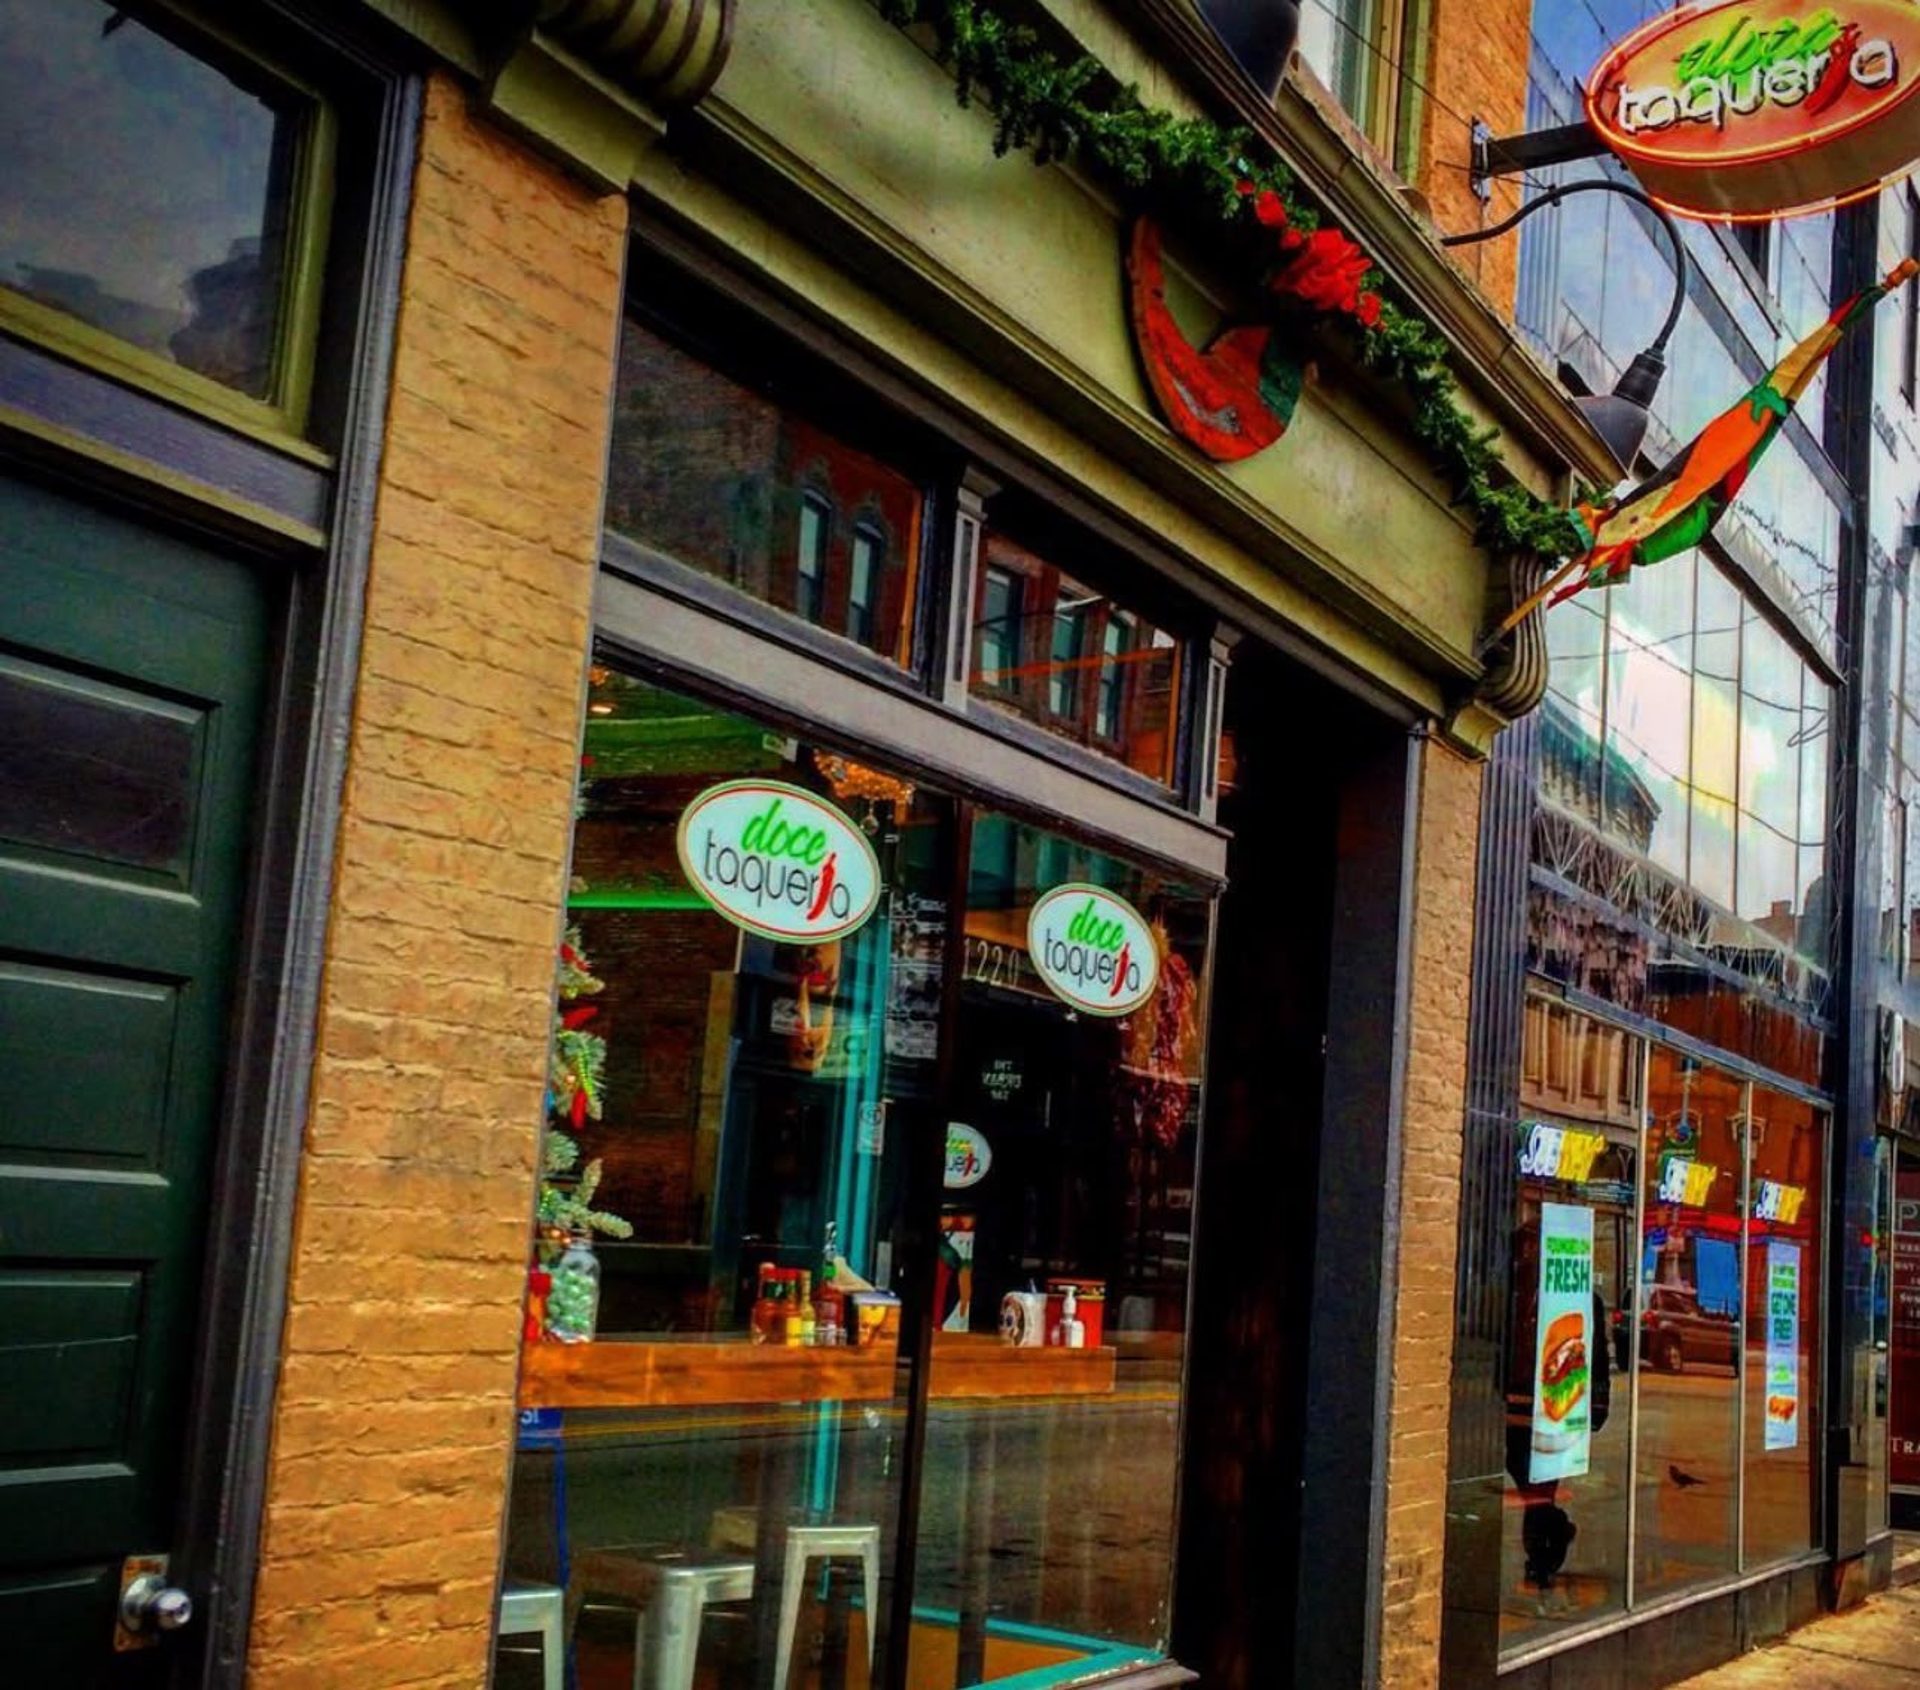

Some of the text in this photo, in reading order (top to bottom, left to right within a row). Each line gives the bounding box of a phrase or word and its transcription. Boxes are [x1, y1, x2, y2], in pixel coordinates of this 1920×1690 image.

[741, 799, 826, 866] doce
[1067, 898, 1124, 953] doce
[1545, 1258, 1591, 1293] FRESH
